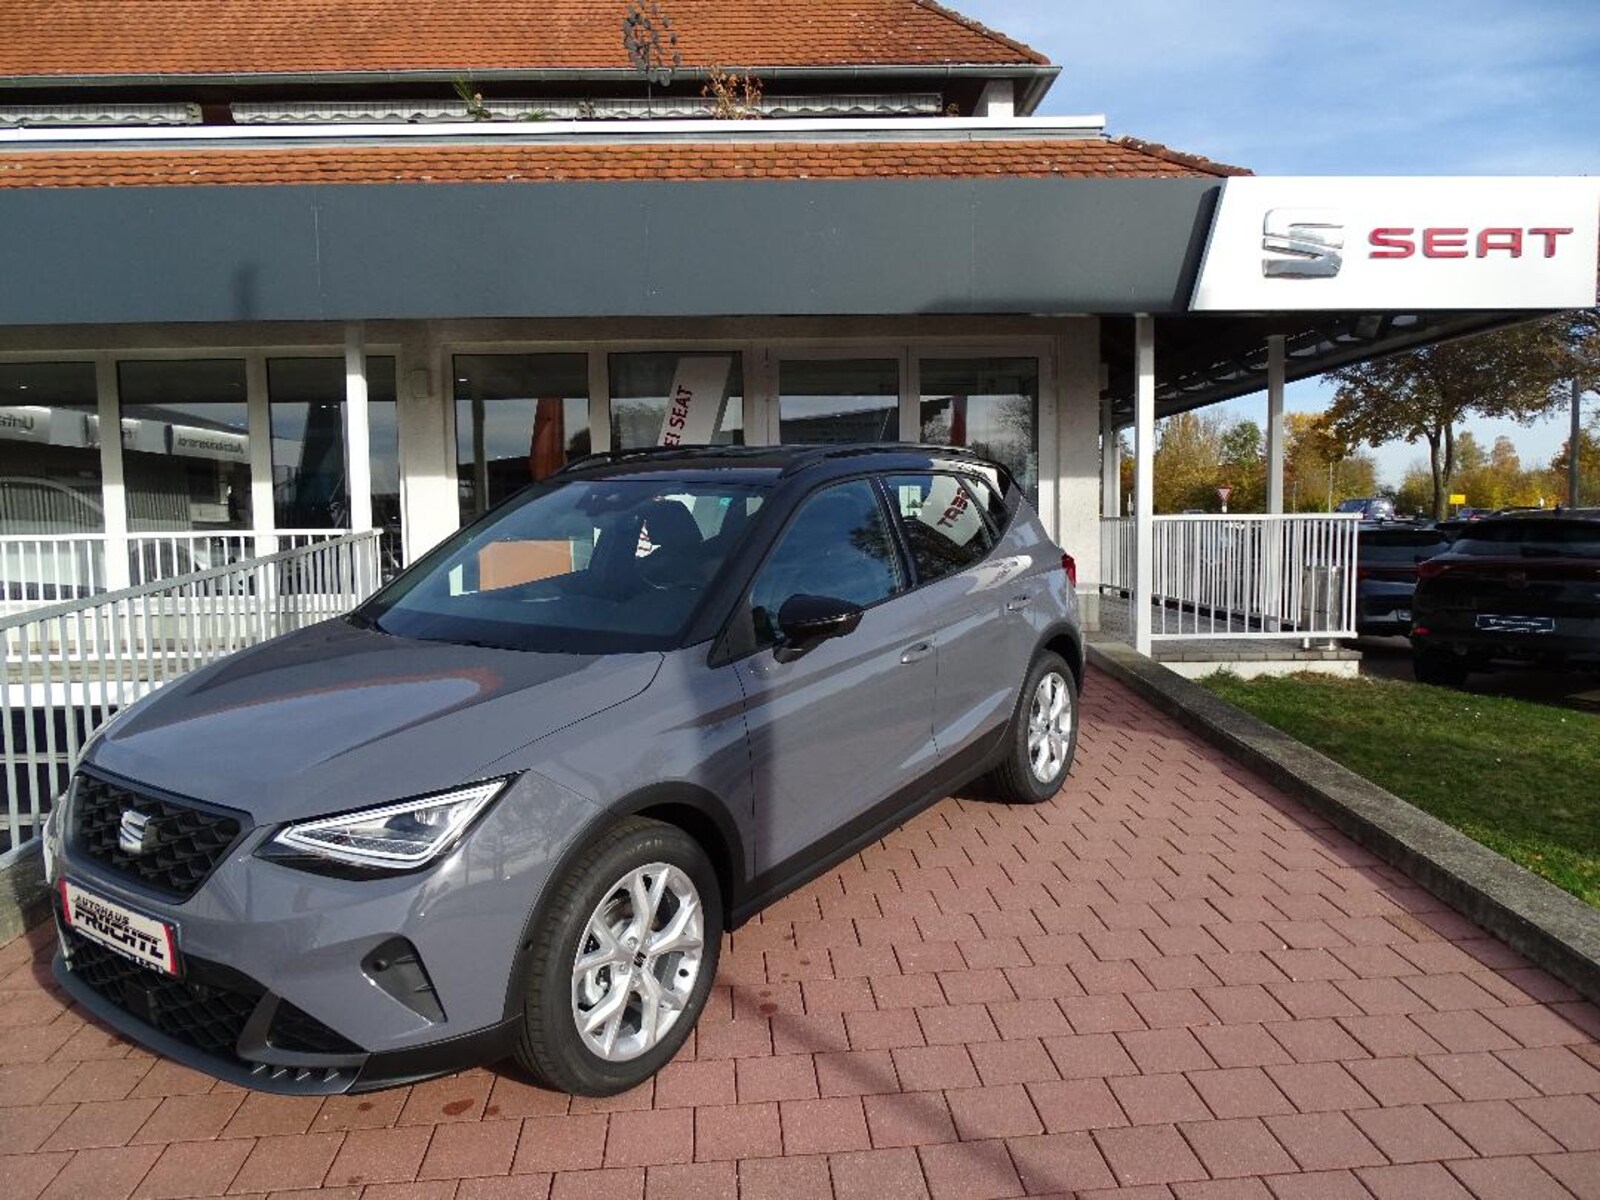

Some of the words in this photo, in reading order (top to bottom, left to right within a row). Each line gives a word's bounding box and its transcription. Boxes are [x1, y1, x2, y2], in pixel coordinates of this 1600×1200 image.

[1368, 227, 1574, 259] SEAT
[669, 385, 693, 430] SEAT
[71, 894, 130, 925] AUTOHAUS
